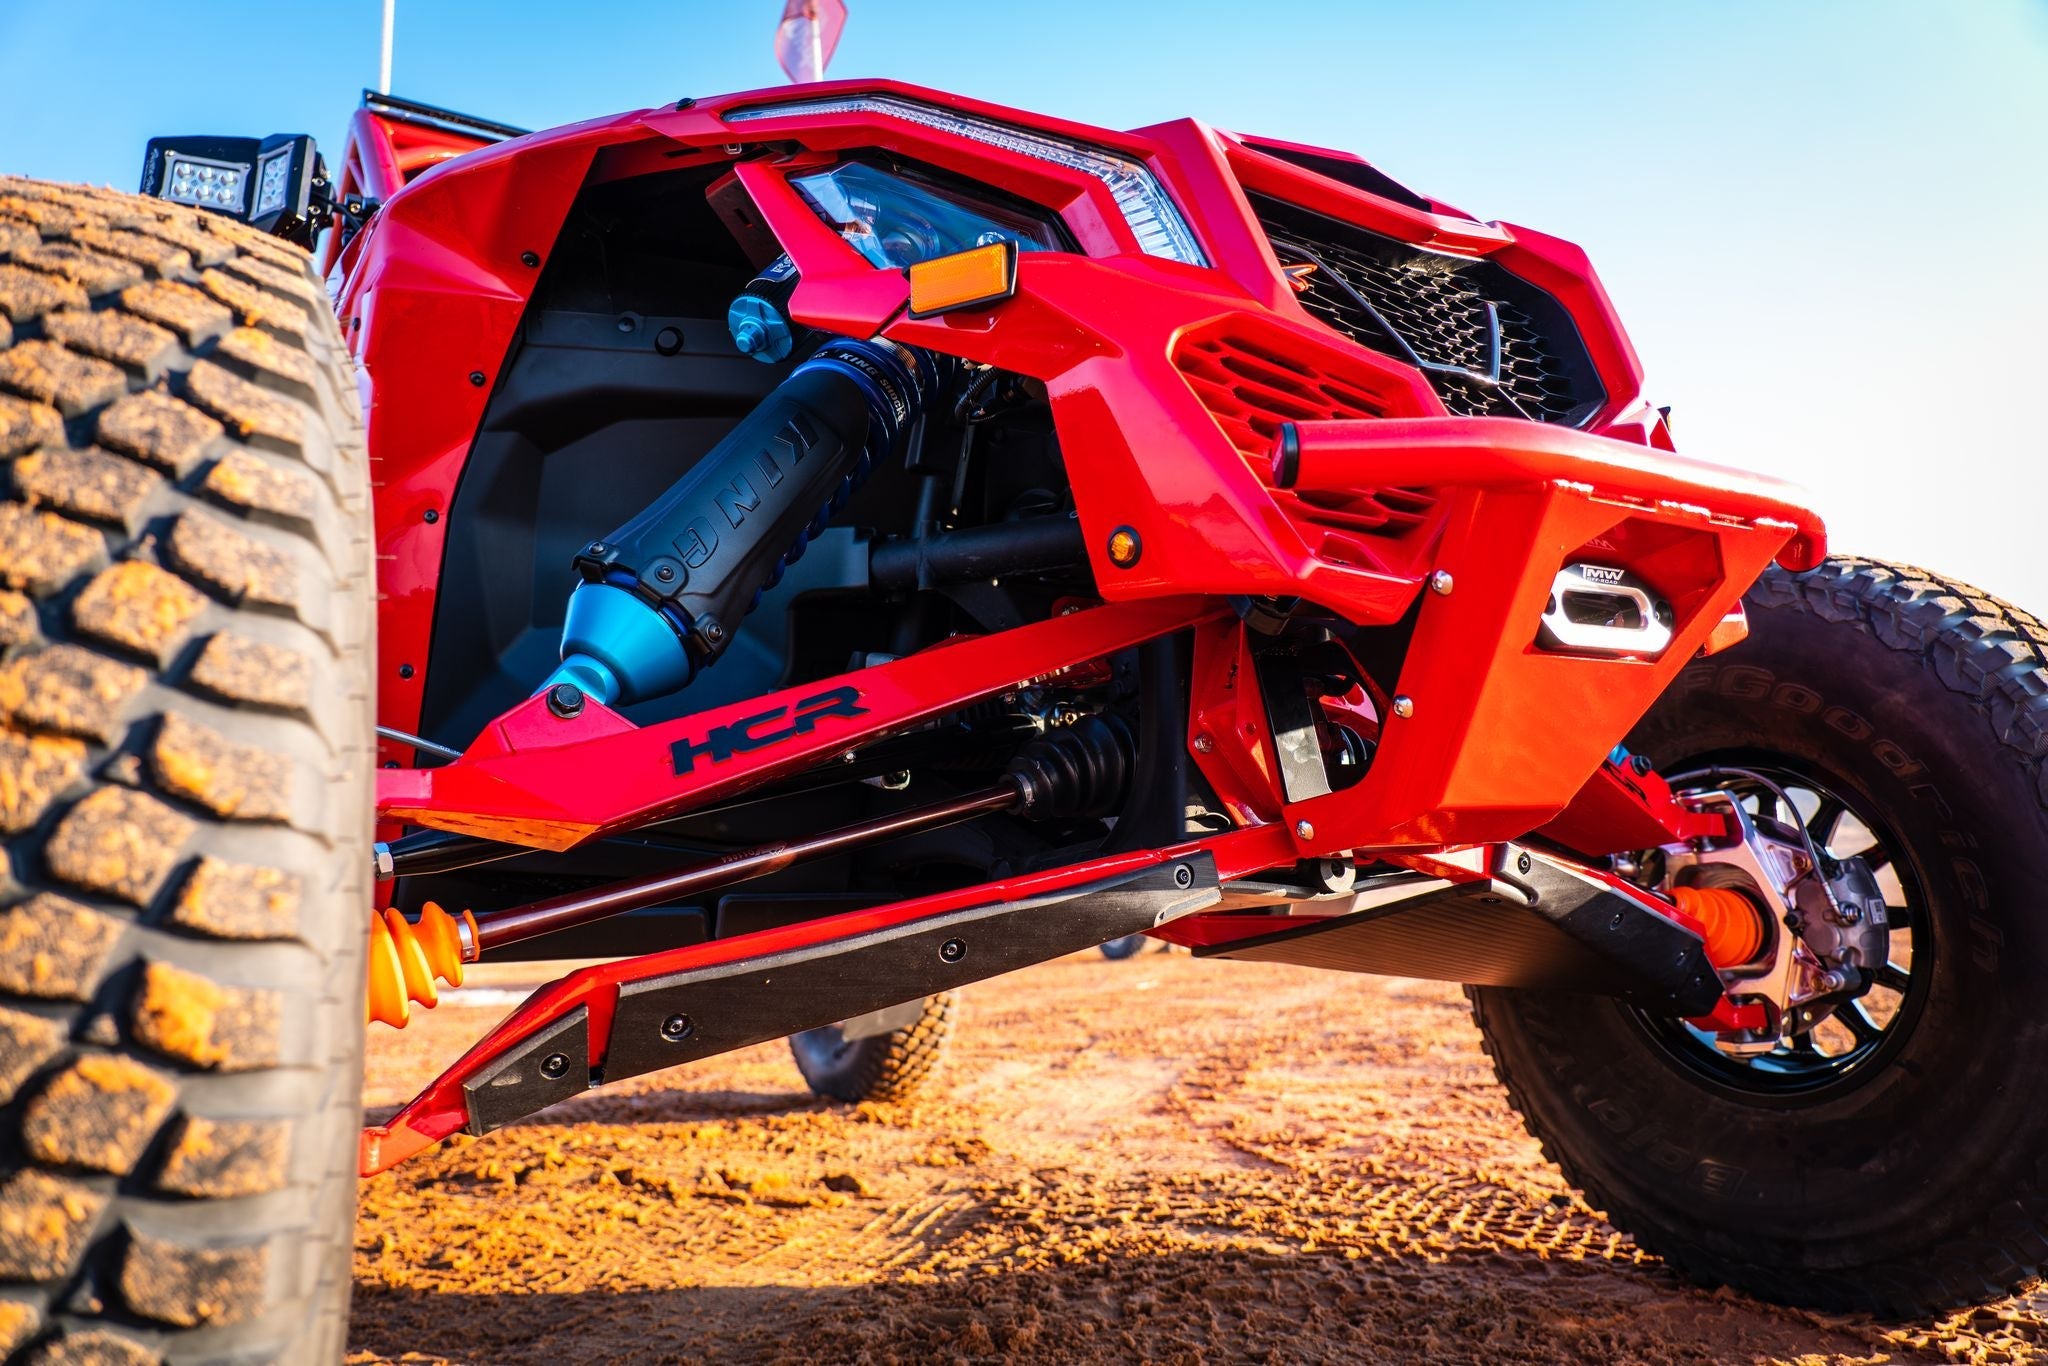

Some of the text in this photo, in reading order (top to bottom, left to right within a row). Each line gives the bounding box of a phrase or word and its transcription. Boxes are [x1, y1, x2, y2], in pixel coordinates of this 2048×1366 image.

[839, 352, 878, 376] KING
[672, 413, 820, 570] KING
[1580, 564, 1625, 580] TMW
[670, 686, 871, 777] HCR
[1675, 664, 2006, 974] FGoodrich
